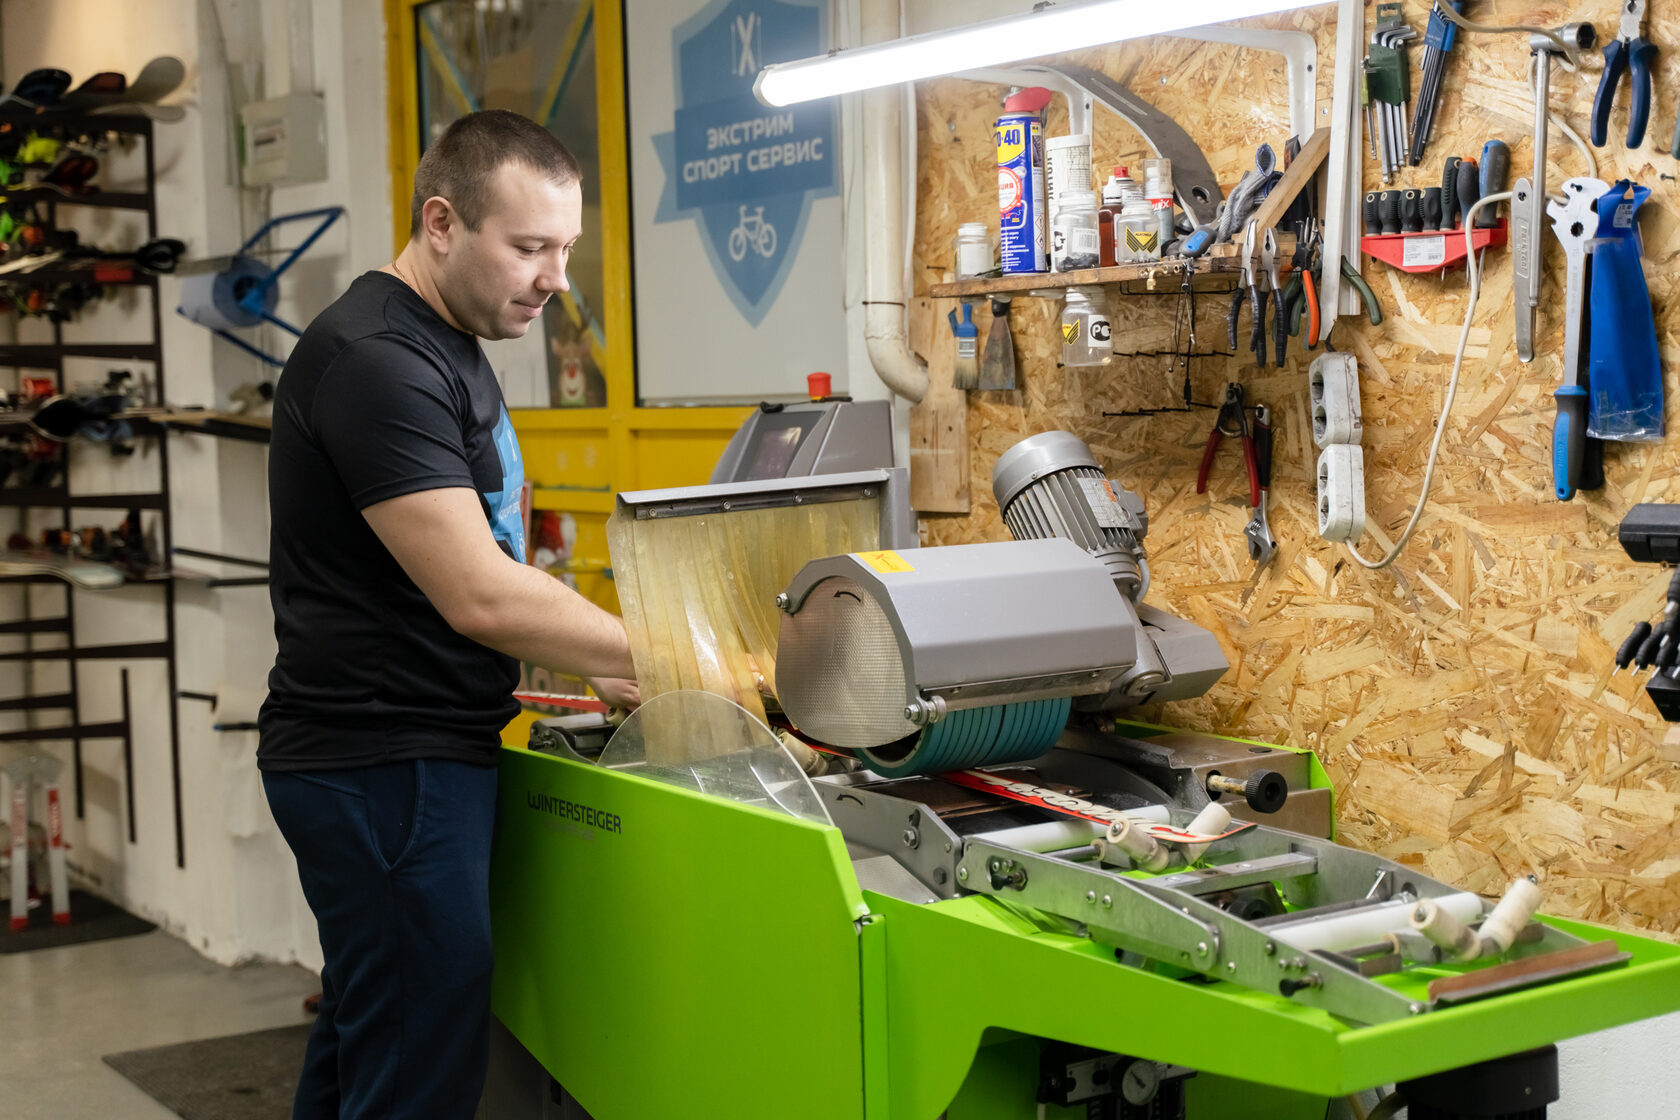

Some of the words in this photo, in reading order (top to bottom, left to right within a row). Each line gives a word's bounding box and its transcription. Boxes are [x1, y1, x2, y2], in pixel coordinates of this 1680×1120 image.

[706, 112, 795, 150] ЭКСТРИМ
[683, 153, 742, 184] СПОРТ
[746, 137, 824, 173] СЕРВИС
[527, 790, 622, 834] WINTERSTEIGER
